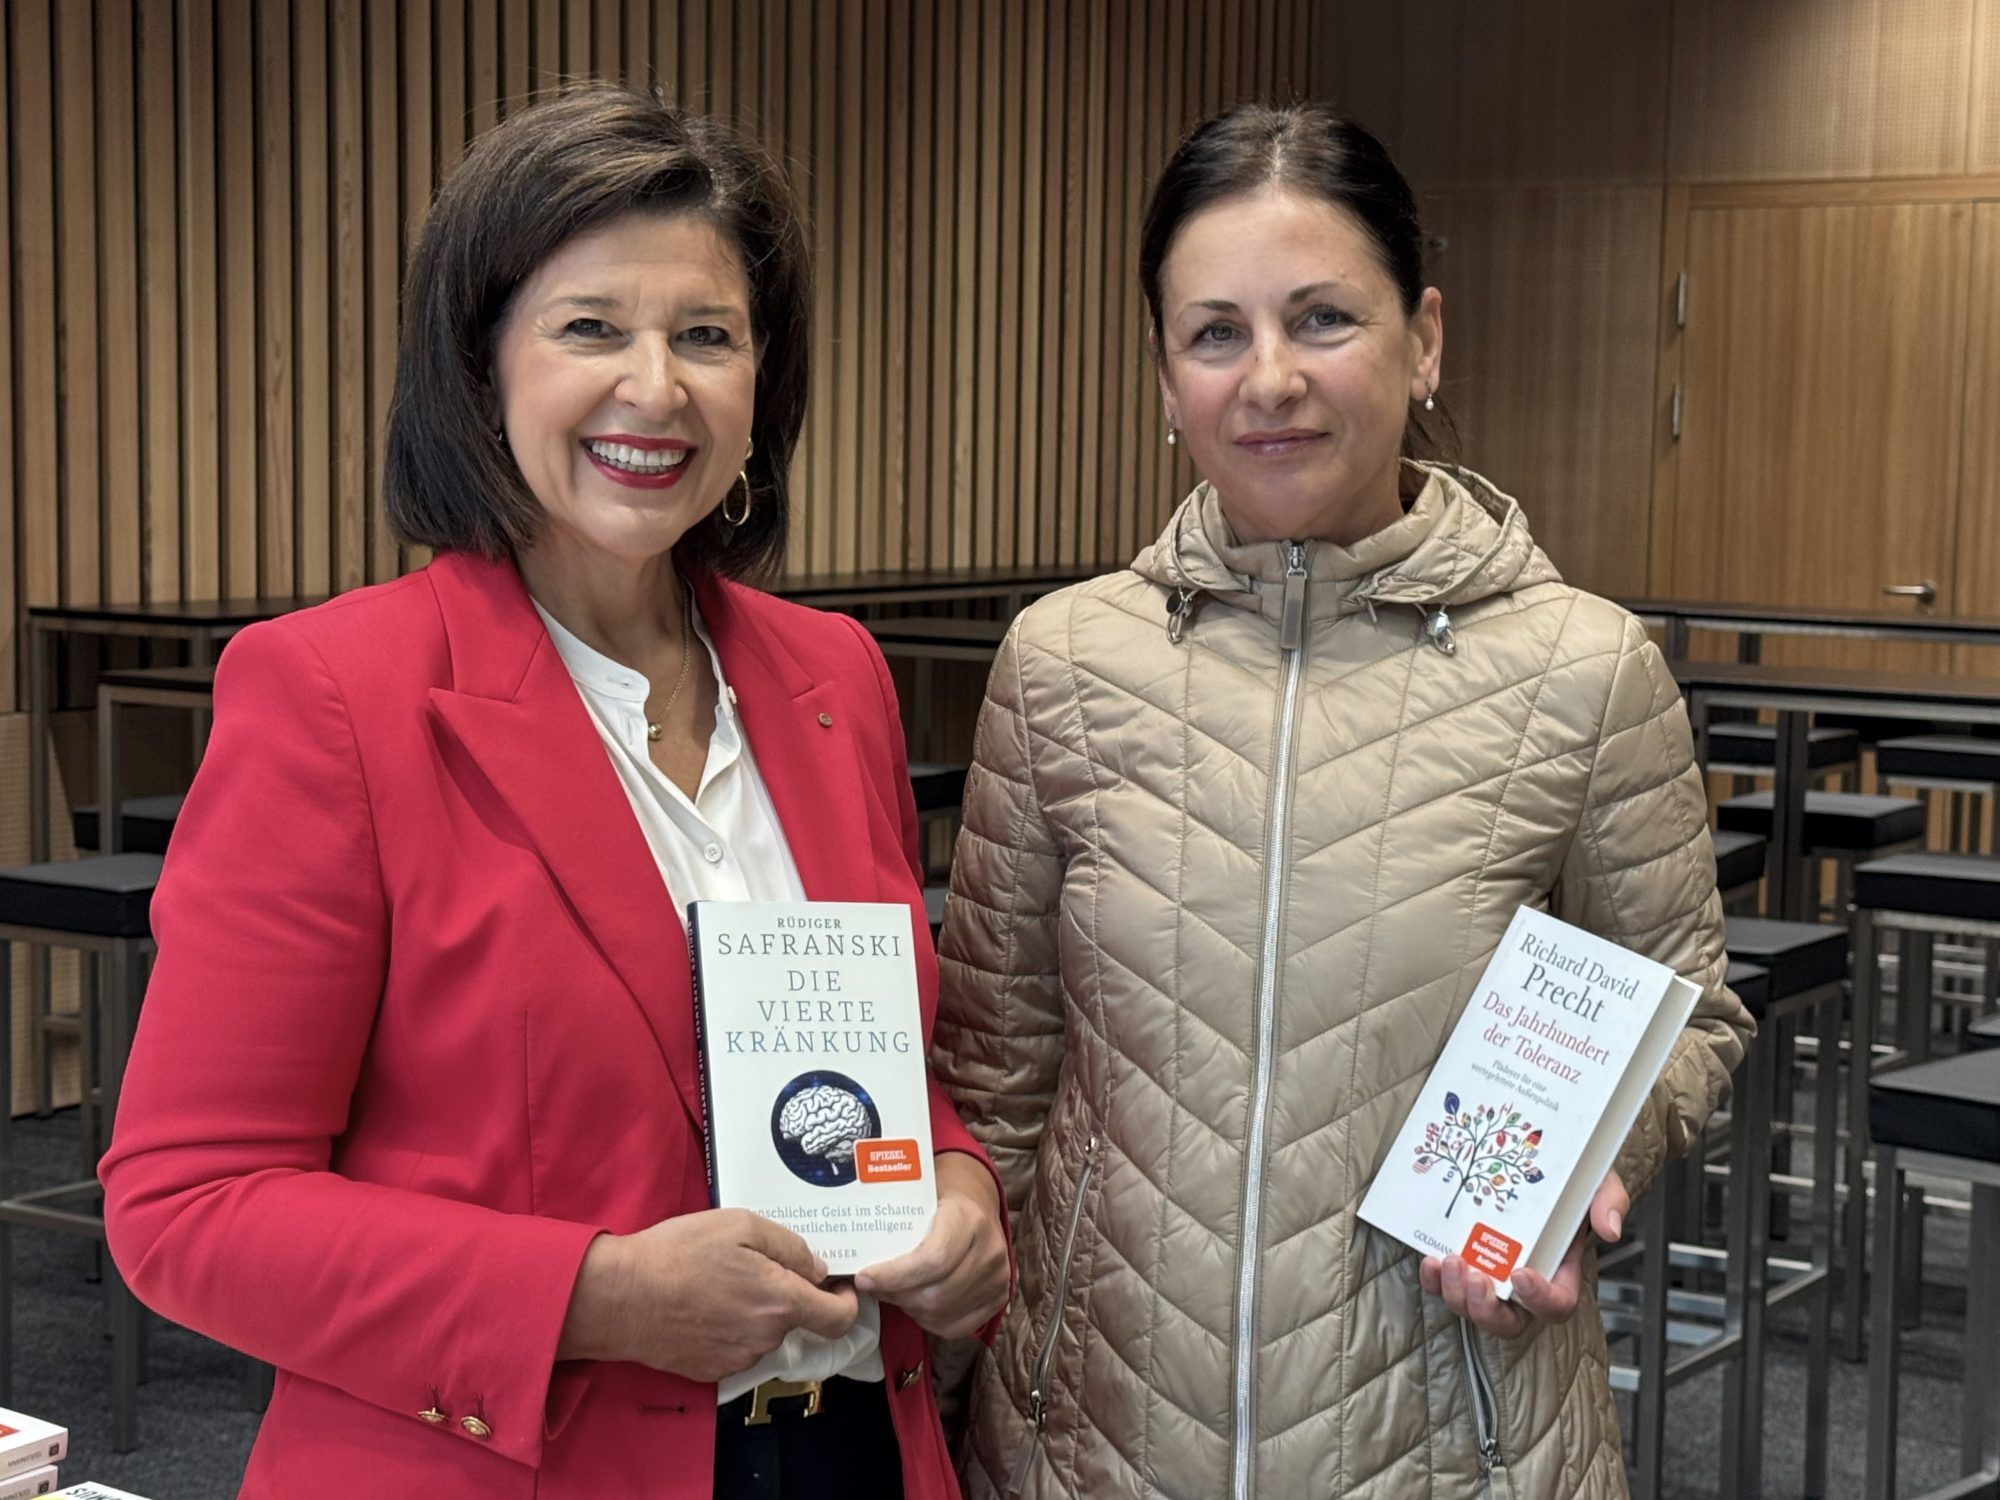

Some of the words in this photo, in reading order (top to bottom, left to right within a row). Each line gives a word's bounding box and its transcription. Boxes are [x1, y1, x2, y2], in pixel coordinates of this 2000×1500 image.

[777, 916, 842, 929] RÜDIGER
[718, 933, 901, 956] SAFRANSKI
[1519, 932, 1588, 978] Richard
[1585, 961, 1640, 1001] David
[787, 970, 841, 991] DIE
[1520, 962, 1605, 1023] Precht
[757, 1000, 875, 1022] VIERTE
[725, 1026, 910, 1053] KRÄNKUNG
[1482, 990, 1513, 1020] Das
[1507, 1005, 1610, 1066] Jahrhundert
[1482, 1022, 1511, 1049] der
[1514, 1035, 1582, 1085] Toleranz
[1492, 1059, 1521, 1082] Plädoyer
[1520, 1073, 1532, 1085] für
[1531, 1081, 1547, 1092] eine
[1517, 1085, 1560, 1112] Außenpolitik
[867, 1163, 912, 1173] Bestseller
[822, 1205, 851, 1218] Geist
[855, 1205, 871, 1217] im
[874, 1204, 925, 1217] Schatten
[851, 1219, 914, 1235] Intelligenz
